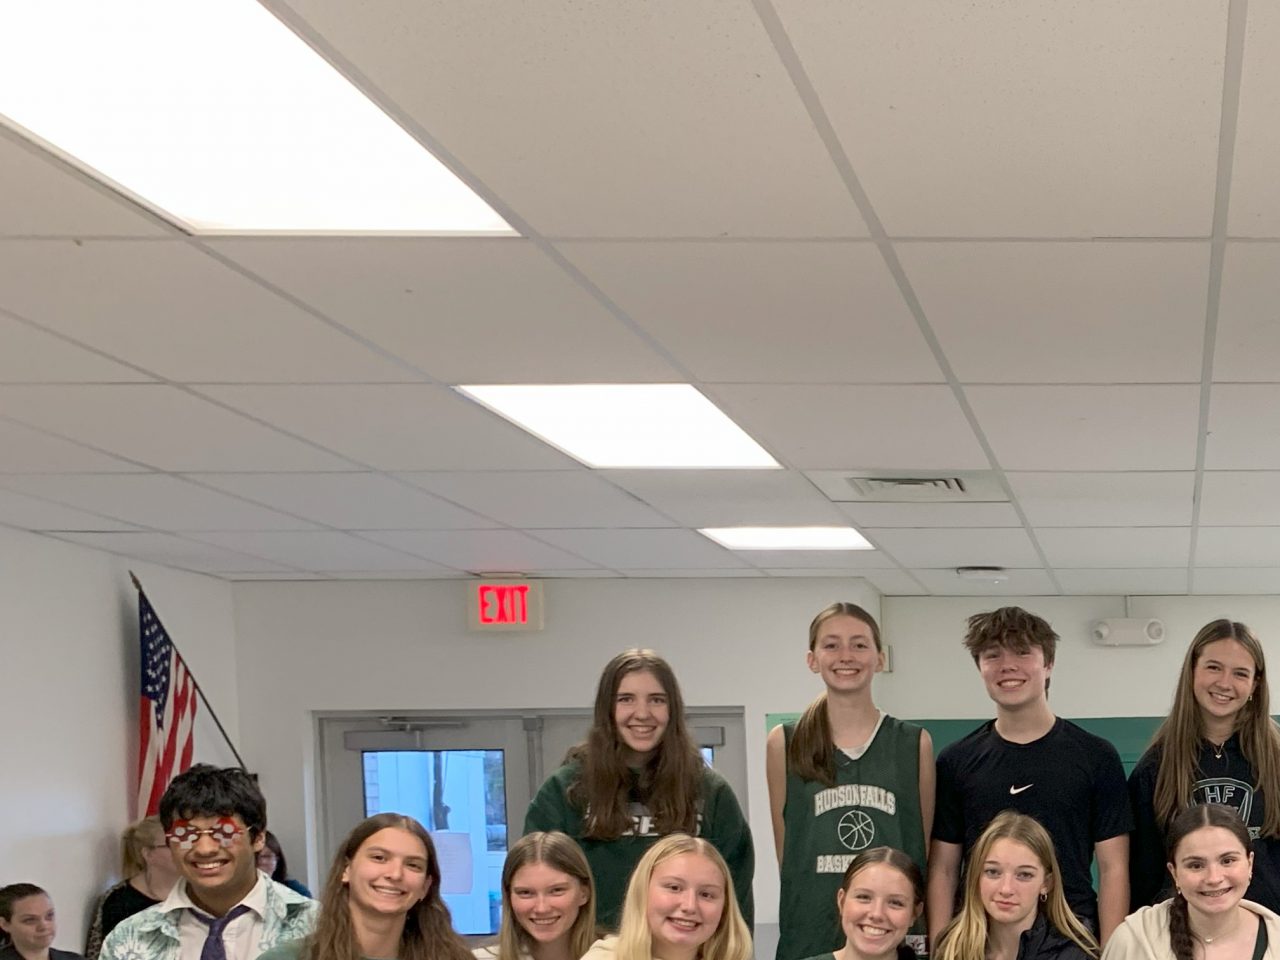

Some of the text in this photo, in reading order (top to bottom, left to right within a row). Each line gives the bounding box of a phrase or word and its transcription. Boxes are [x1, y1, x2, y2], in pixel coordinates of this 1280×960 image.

[479, 585, 529, 624] EXIT
[814, 784, 896, 816] HUDSON FALLS
[1204, 785, 1236, 804] HF
